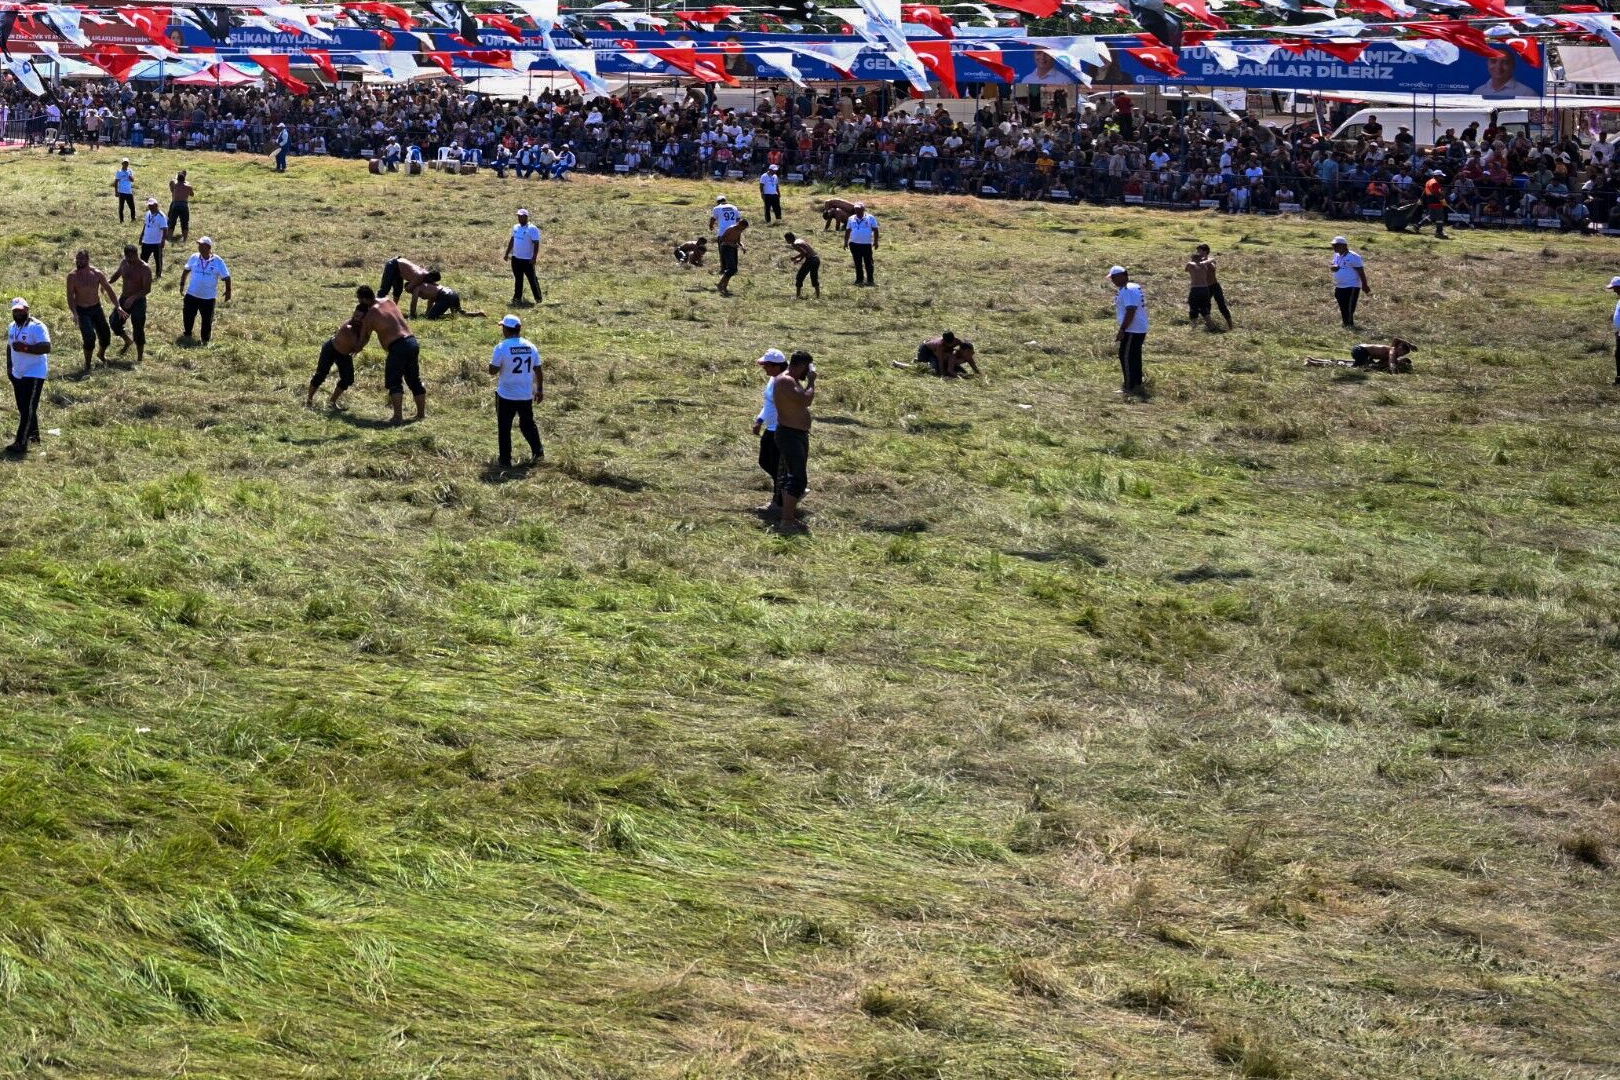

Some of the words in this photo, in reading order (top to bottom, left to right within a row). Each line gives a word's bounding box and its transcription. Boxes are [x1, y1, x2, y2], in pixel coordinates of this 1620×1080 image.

[1317, 63, 1393, 79] DİLERİZ
[724, 212, 735, 221] 92
[512, 356, 531, 373] 21
